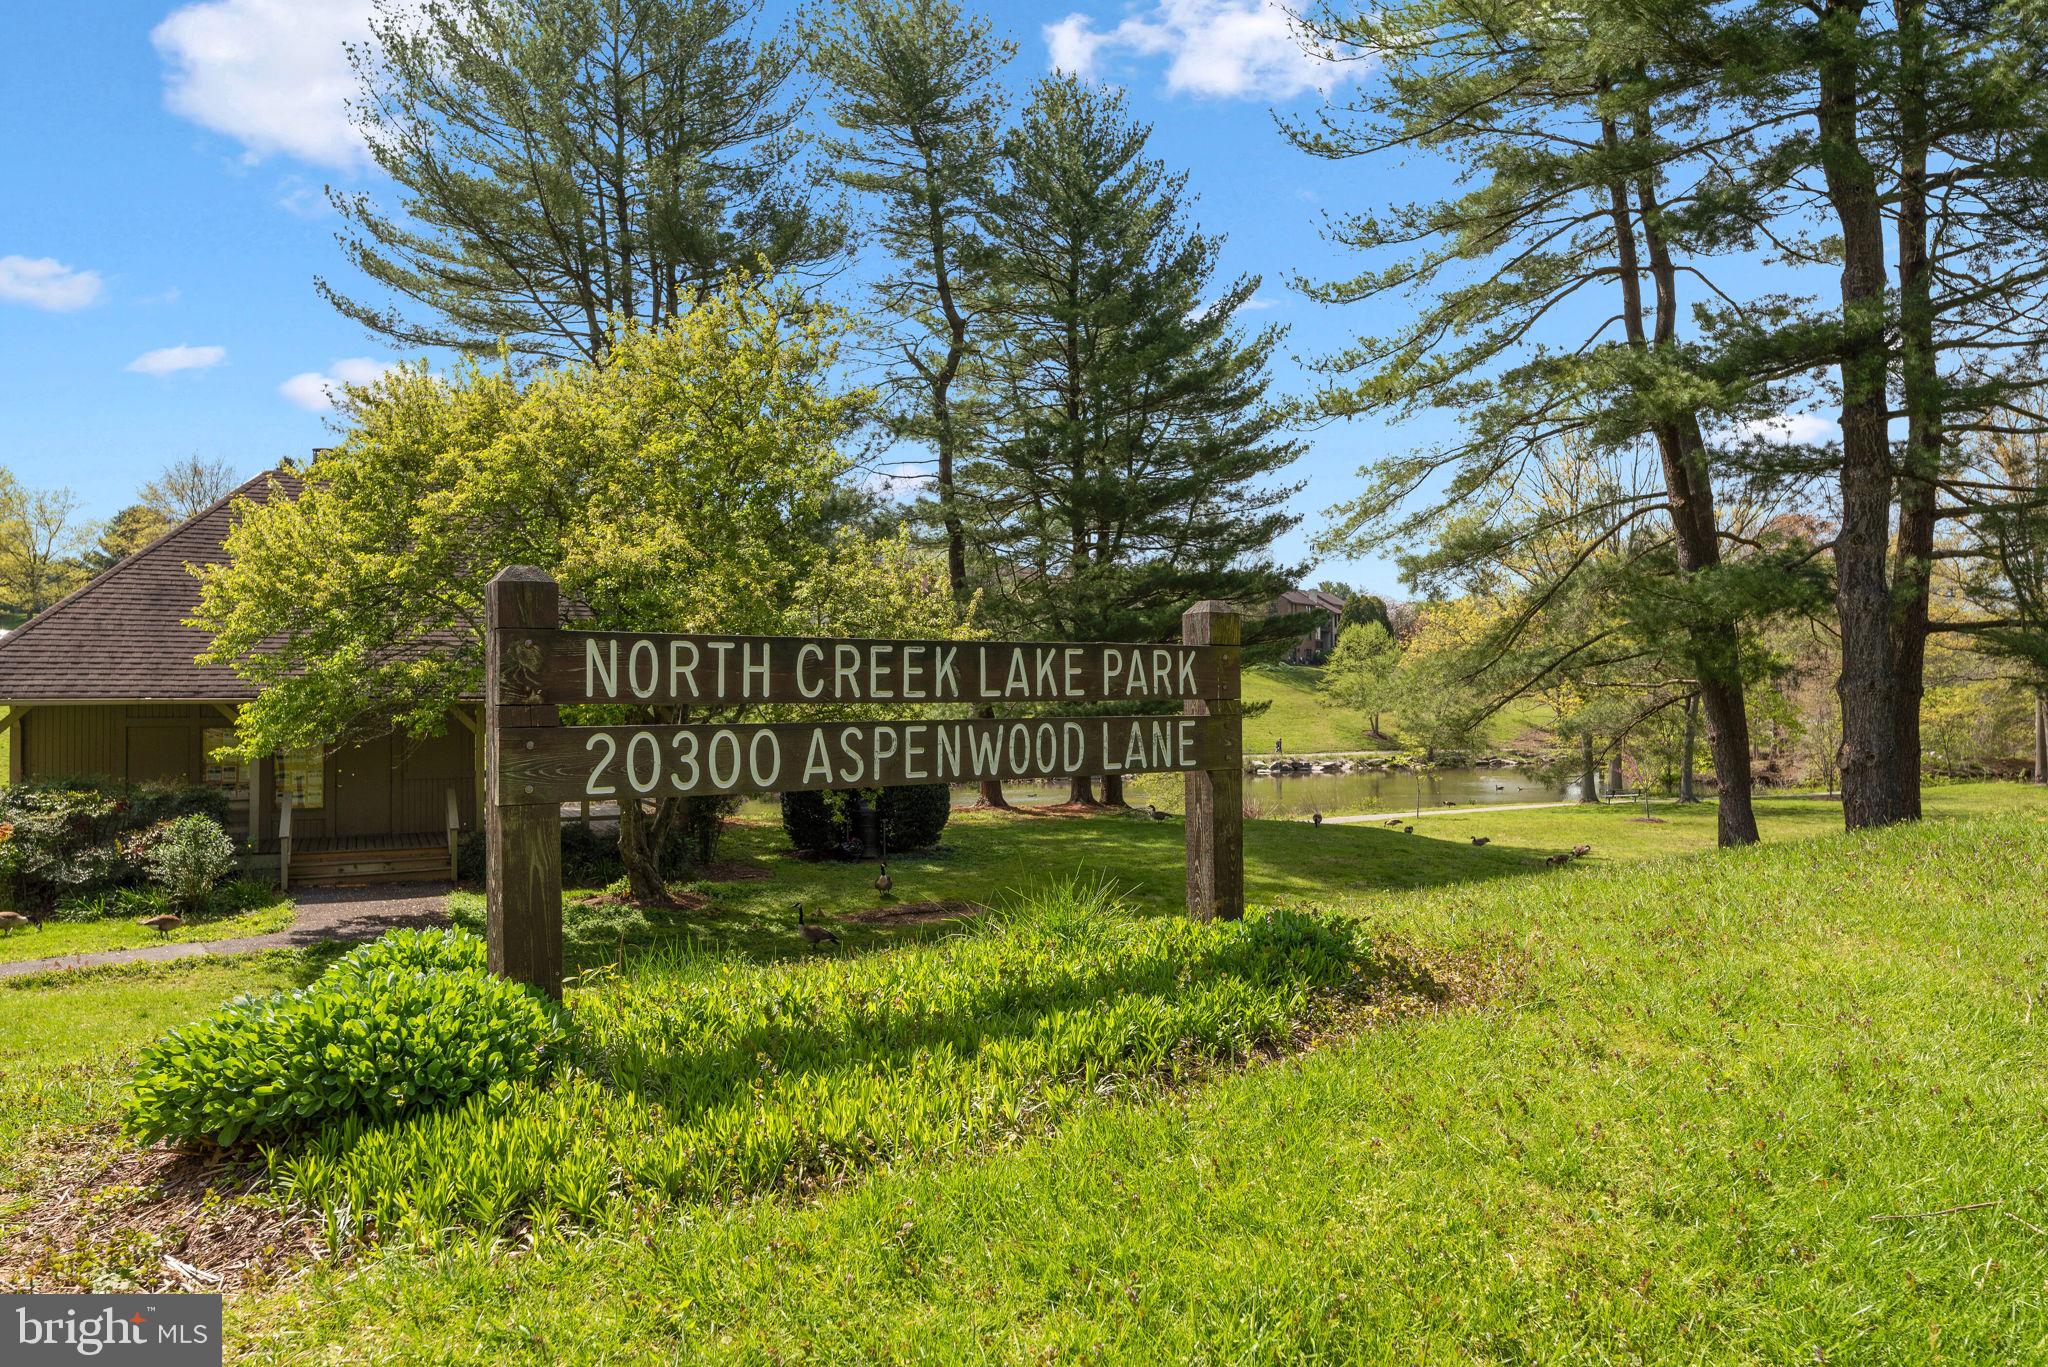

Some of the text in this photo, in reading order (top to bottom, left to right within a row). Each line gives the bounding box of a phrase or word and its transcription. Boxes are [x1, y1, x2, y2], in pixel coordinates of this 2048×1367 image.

[585, 638, 1198, 699] NORTH CREEK LAKE PARK
[585, 719, 1197, 794] 20300 ASPENWOOD LANE
